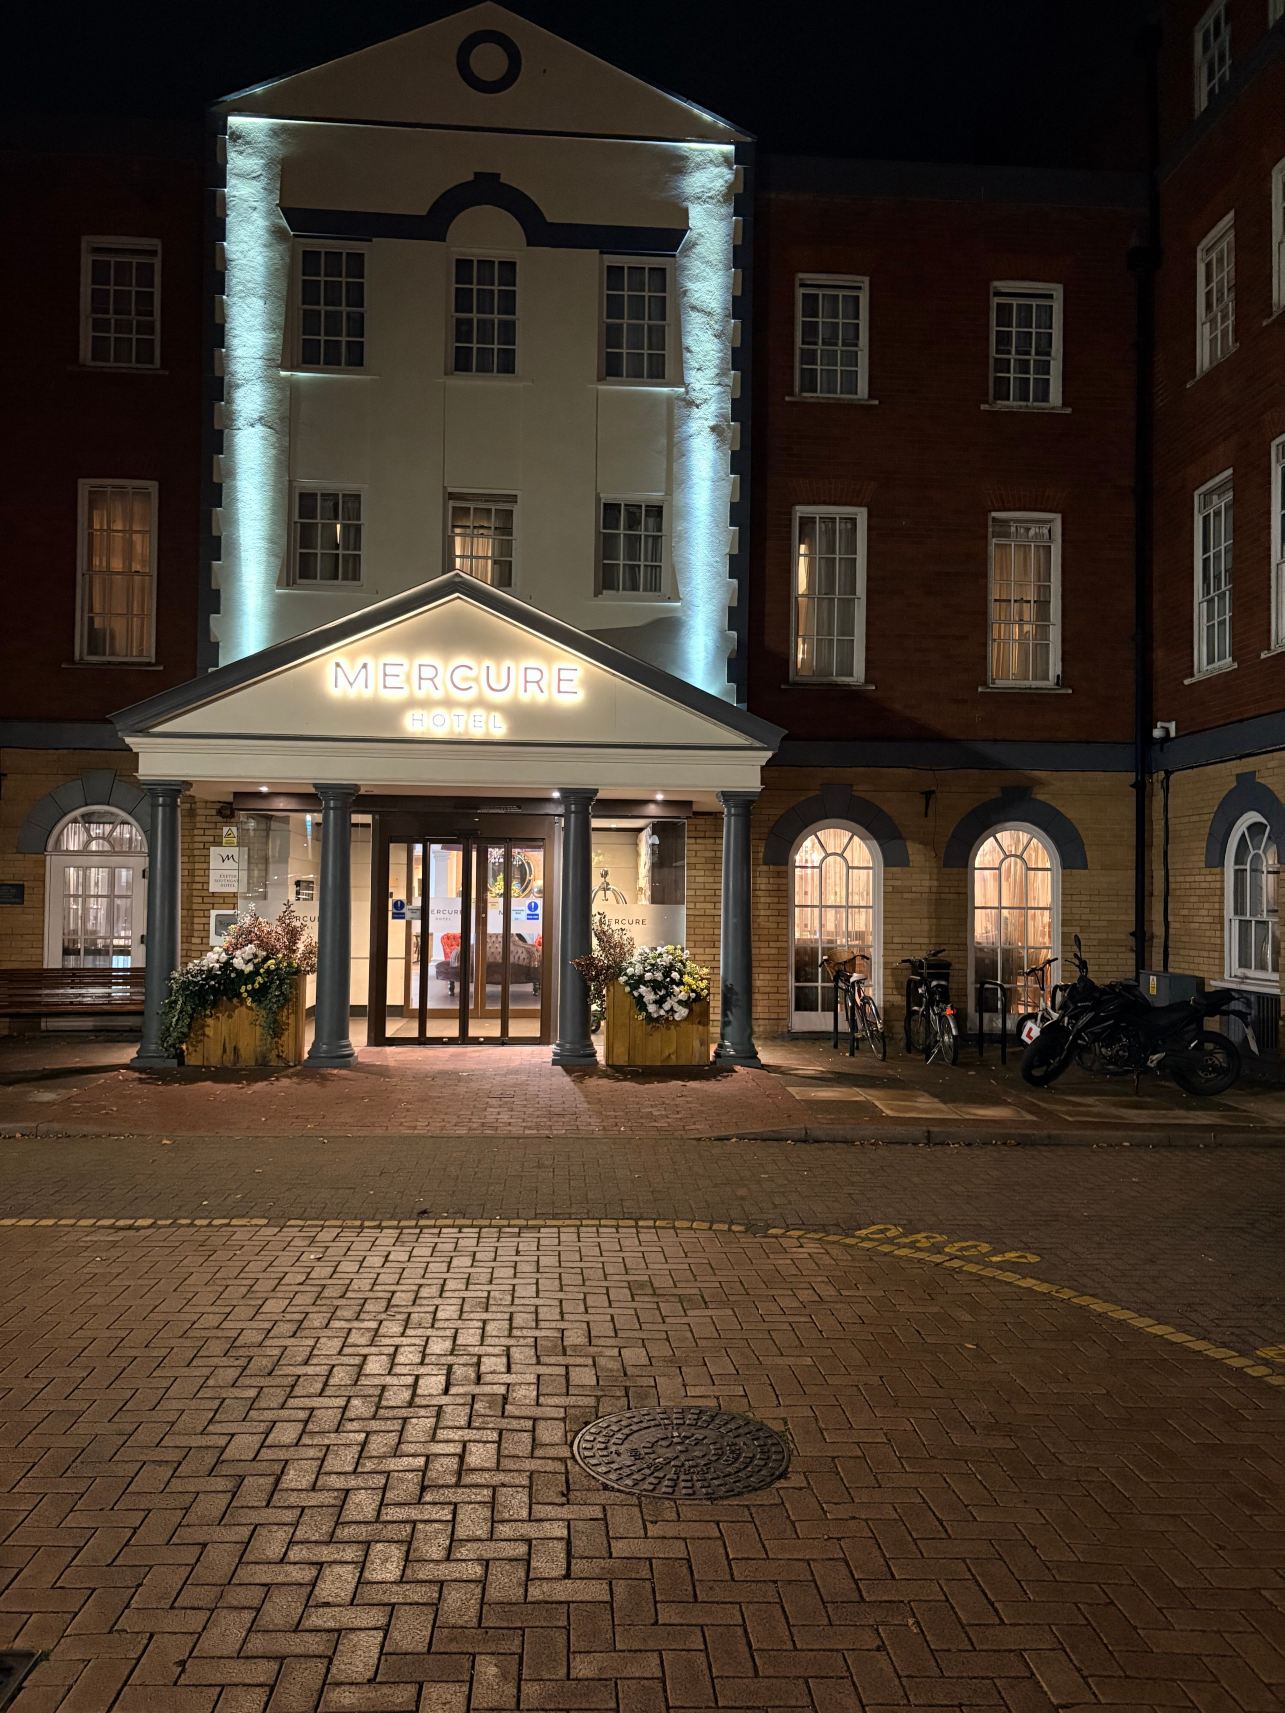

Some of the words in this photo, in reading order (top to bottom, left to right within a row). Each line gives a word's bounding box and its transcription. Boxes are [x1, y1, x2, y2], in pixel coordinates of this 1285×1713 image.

[334, 661, 578, 694] MERCURE
[411, 713, 502, 729] HOTEL
[1025, 1026, 1034, 1041] L
